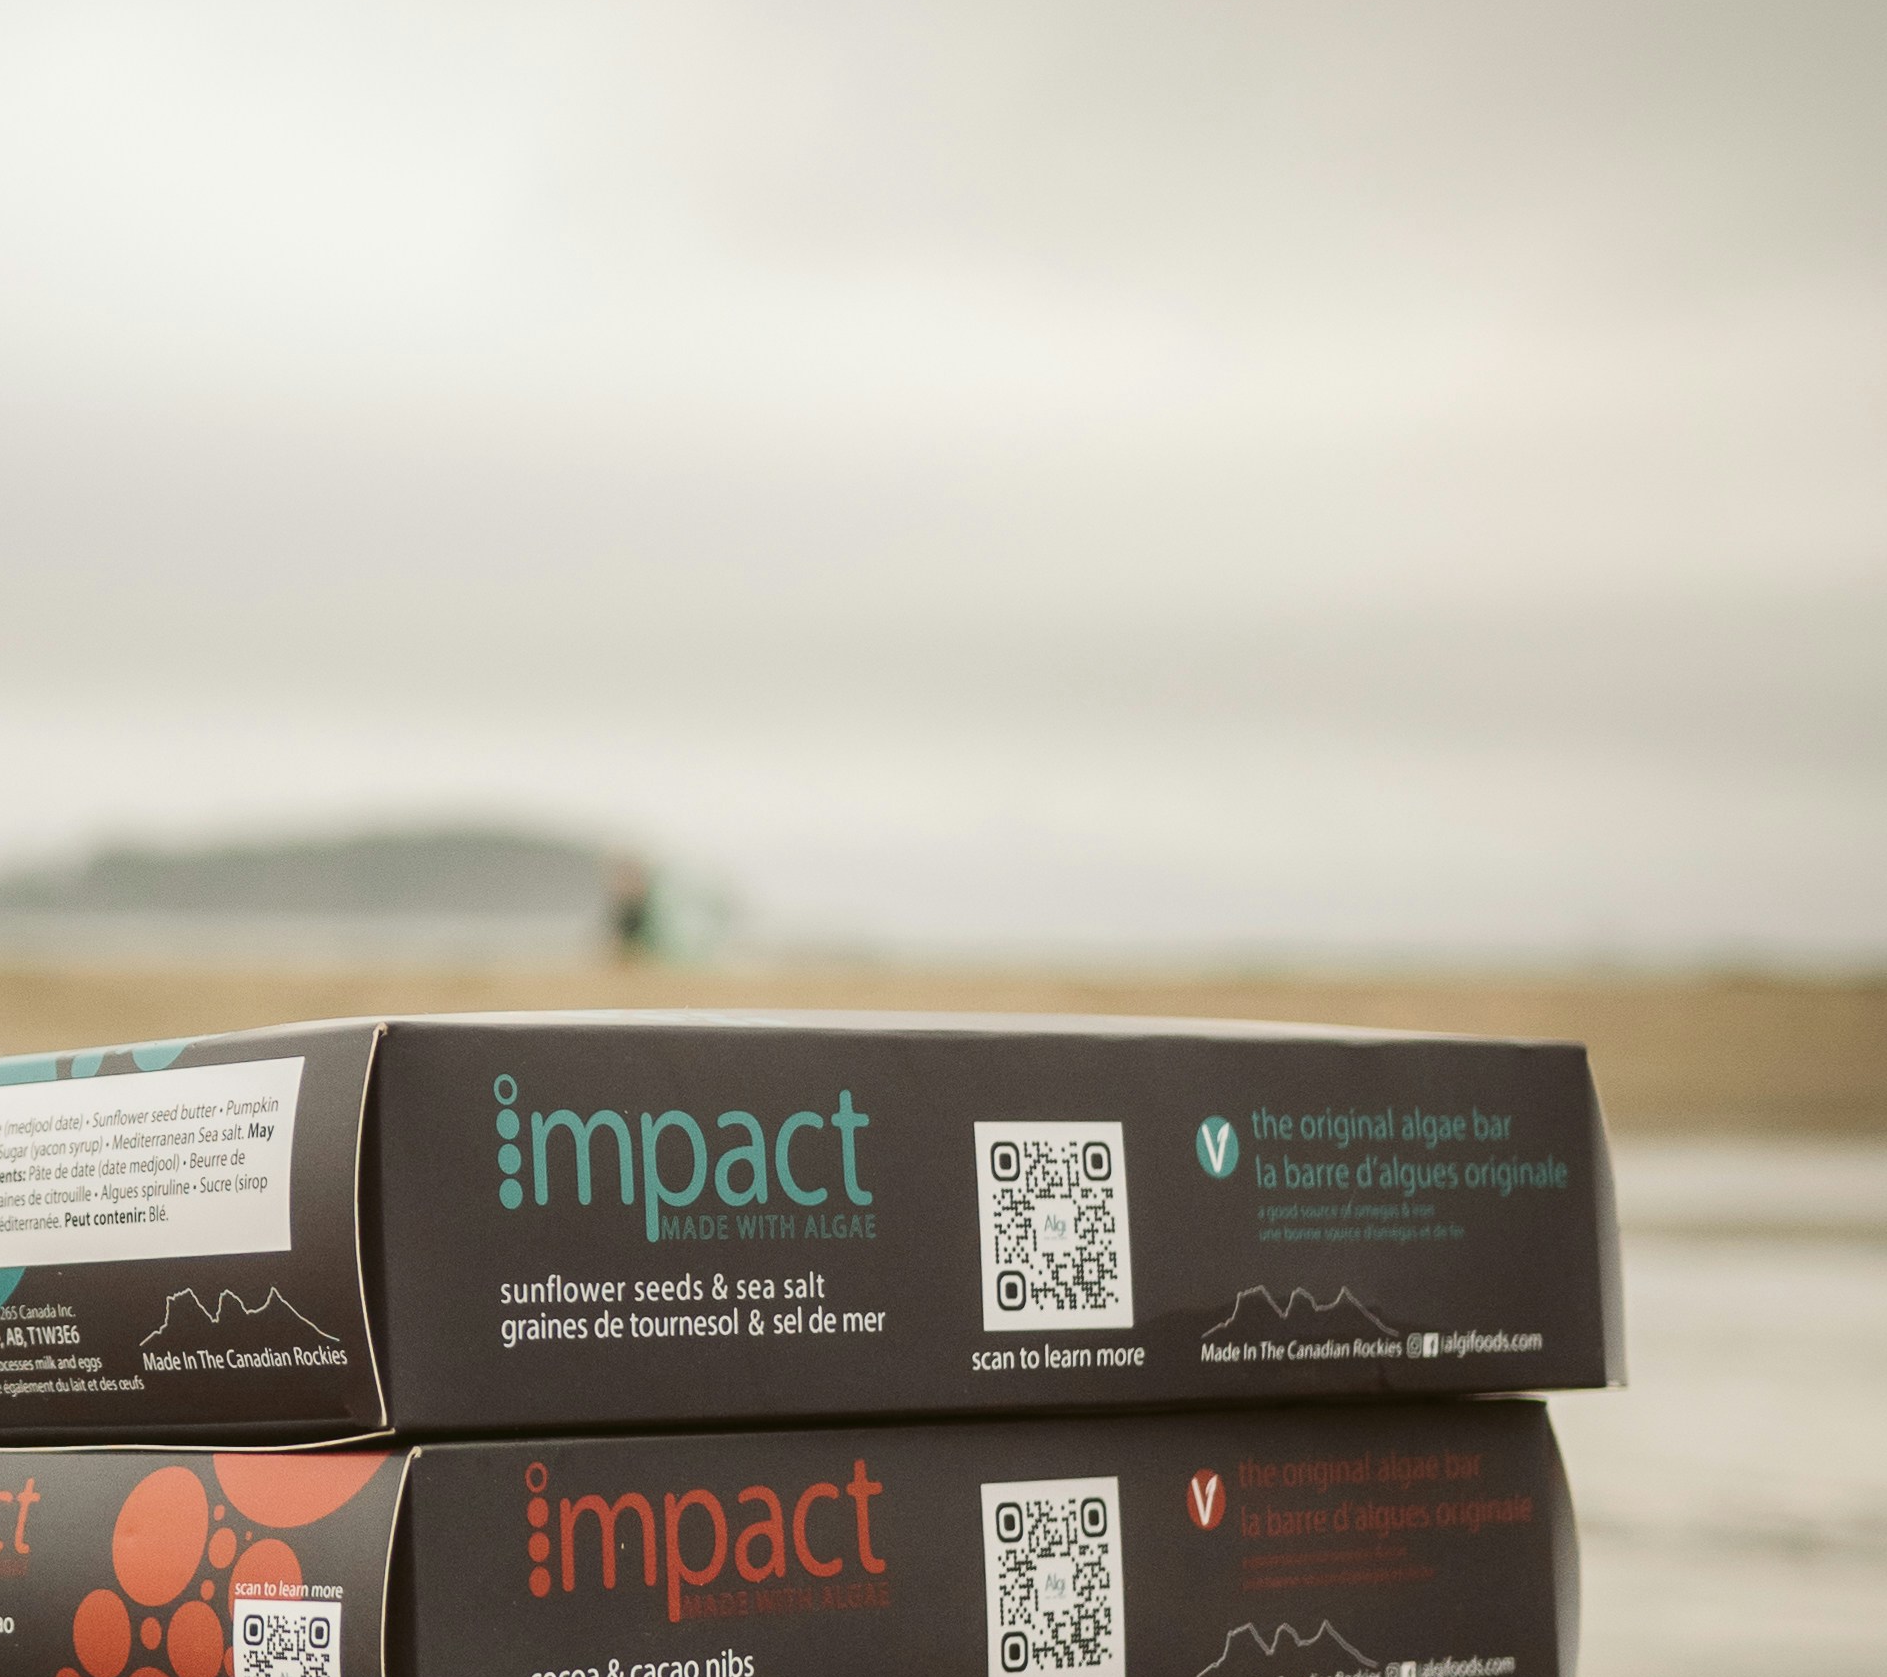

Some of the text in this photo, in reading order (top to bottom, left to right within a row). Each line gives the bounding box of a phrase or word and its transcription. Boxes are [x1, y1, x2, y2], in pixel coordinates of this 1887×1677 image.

[5, 1115, 53, 1137] (medjool
[55, 1113, 83, 1131] date)
[92, 1109, 149, 1128] Sunflower
[151, 1104, 177, 1123] seed
[181, 1104, 217, 1121] butter
[226, 1096, 279, 1118] Pumpkin
[1251, 1107, 1512, 1150] the original algae bar
[31, 1141, 65, 1161] (yacon
[69, 1135, 103, 1156] syrup)
[112, 1131, 195, 1150] Mediterranean
[198, 1127, 218, 1143] Sea
[221, 1124, 244, 1141] salt.
[247, 1122, 274, 1142] May
[28, 1164, 52, 1181] Pâte
[55, 1163, 68, 1179] de
[71, 1161, 95, 1178] date
[98, 1159, 126, 1178] (date
[129, 1153, 180, 1176] medjool)
[189, 1152, 228, 1170] Beurre
[230, 1148, 246, 1166] de
[493, 1074, 873, 1243] impact
[1254, 1154, 1277, 1189] la
[1283, 1154, 1349, 1189] barre
[1464, 1153, 1568, 1197] originale
[28, 1189, 42, 1206] de
[44, 1185, 91, 1205] citrouille
[100, 1184, 139, 1204] Algues
[141, 1179, 190, 1201] spiruline
[200, 1176, 232, 1194] Sucre
[234, 1173, 268, 1194] (sirop
[65, 1210, 91, 1227] Peut
[93, 1207, 146, 1226] contenir:
[149, 1205, 169, 1222] Blé.
[661, 1213, 877, 1240] MADE WITH ALGAE
[500, 1271, 825, 1304] sunflower seeds & sea salt
[18, 1303, 56, 1320] Canada
[57, 1303, 76, 1319] Inc.
[500, 1304, 885, 1348] graines de tournesol & sel de mer
[142, 1344, 348, 1371] Made In The Canadian Rockies
[971, 1343, 1145, 1371] scan to learn more
[1201, 1338, 1402, 1363] Made In The Canadian Rockies
[1238, 1446, 1481, 1493] the original algae bar
[1240, 1504, 1261, 1539] la
[1266, 1500, 1326, 1538] barre
[1434, 1492, 1533, 1535] originale
[525, 1459, 886, 1622] impact
[234, 1579, 344, 1599] scan to learn more
